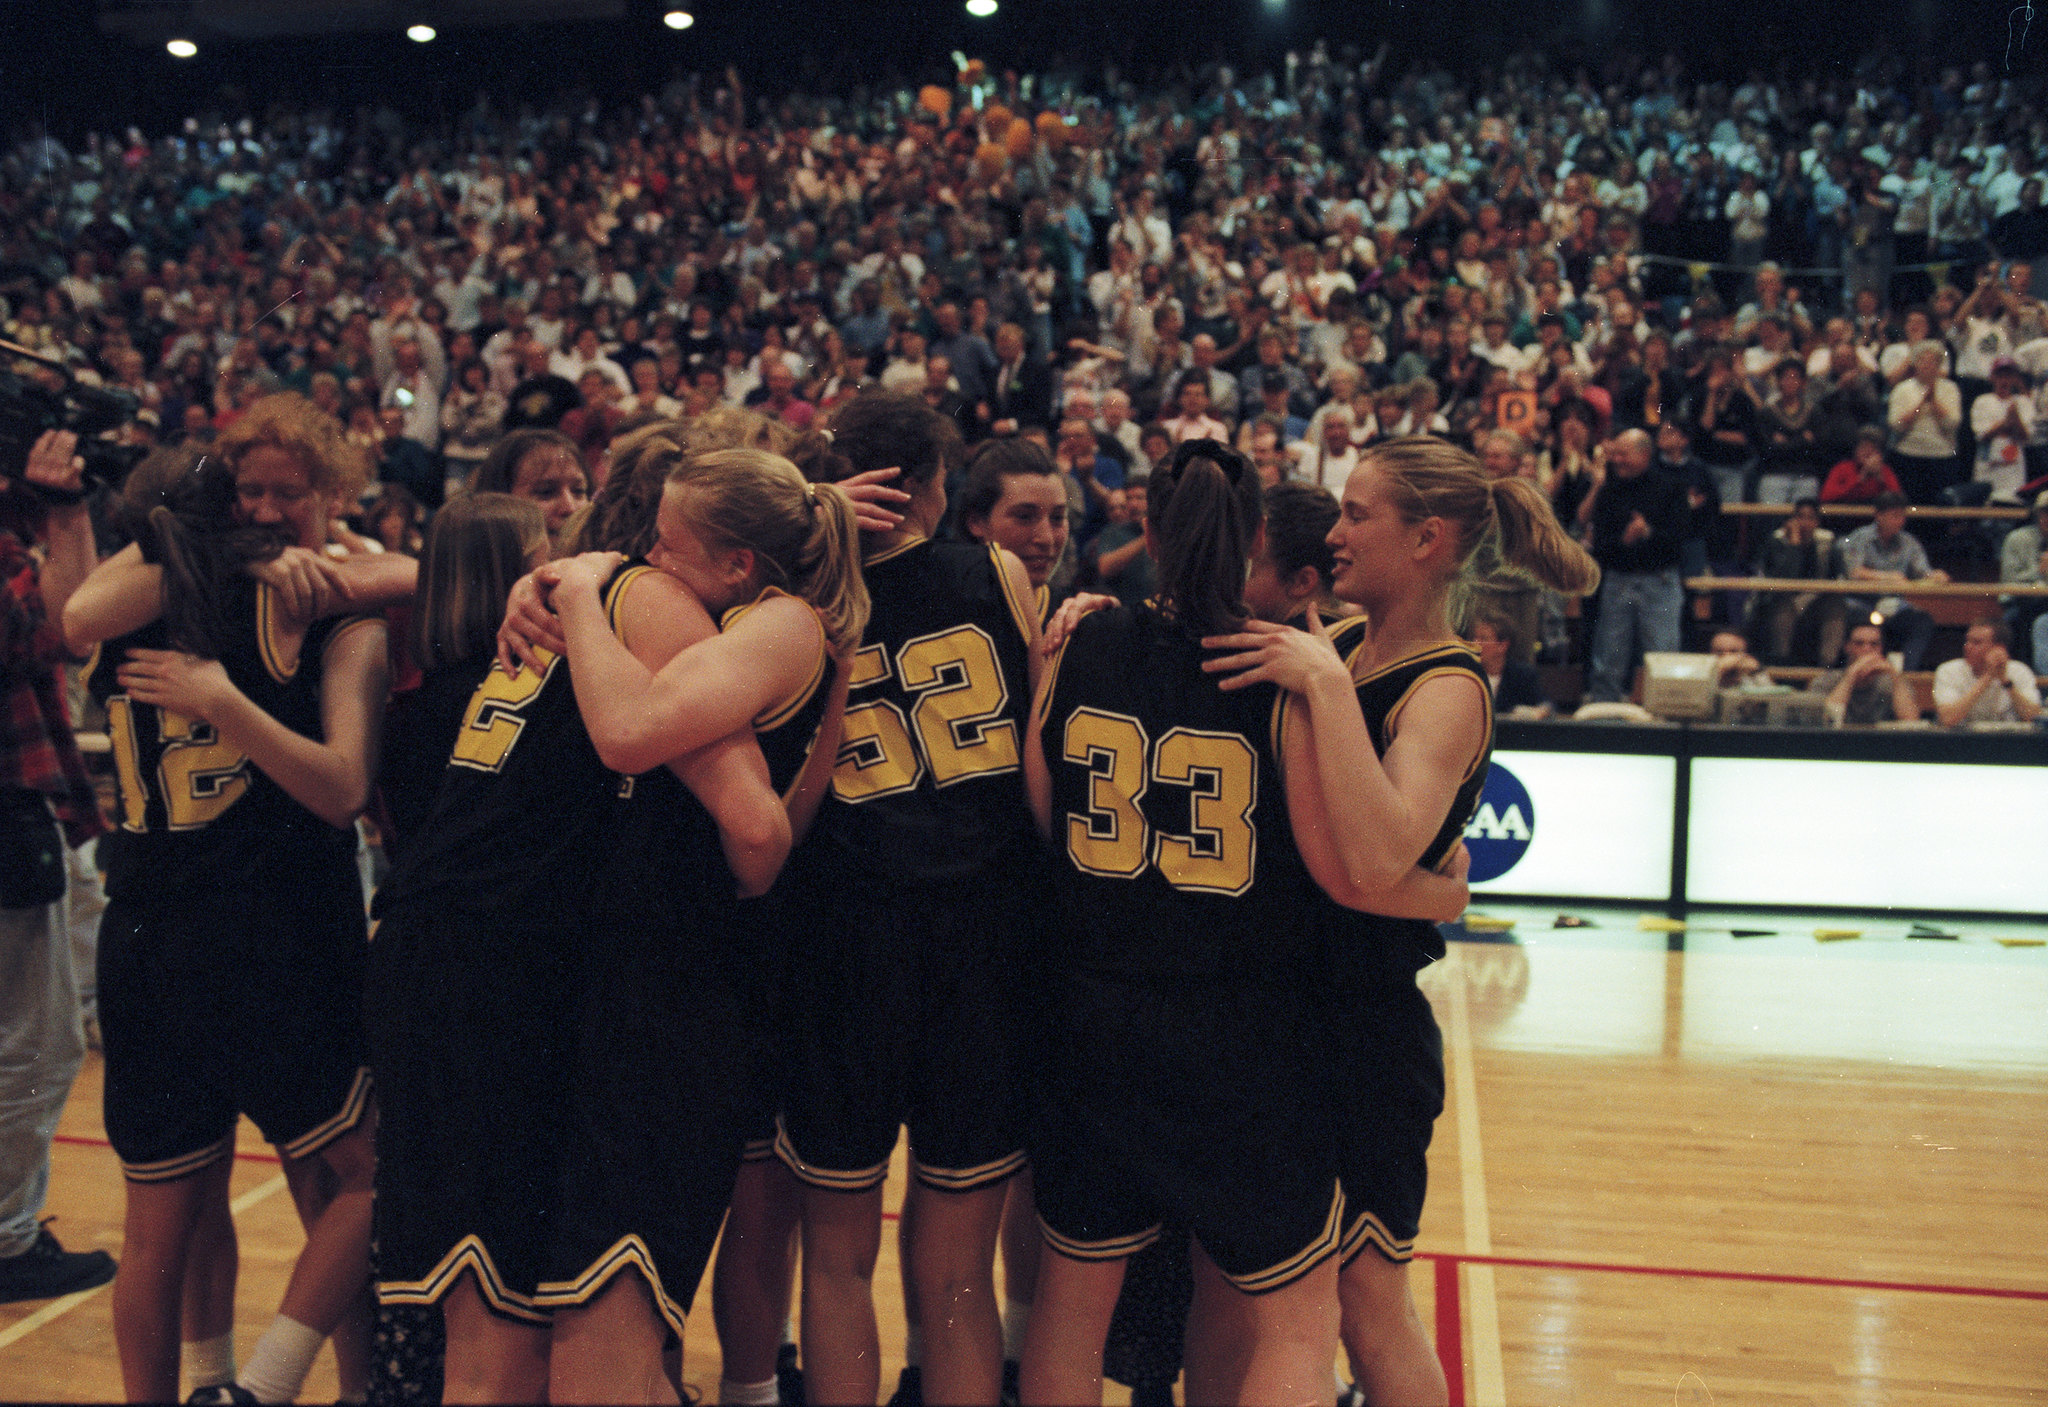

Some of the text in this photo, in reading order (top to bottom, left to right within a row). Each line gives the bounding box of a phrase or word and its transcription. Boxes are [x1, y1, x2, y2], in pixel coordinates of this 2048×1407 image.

[105, 695, 251, 833] 12
[449, 644, 561, 773] 2
[826, 623, 1020, 804] 52
[1063, 706, 1258, 897] 33
[1463, 802, 1531, 840] AA
